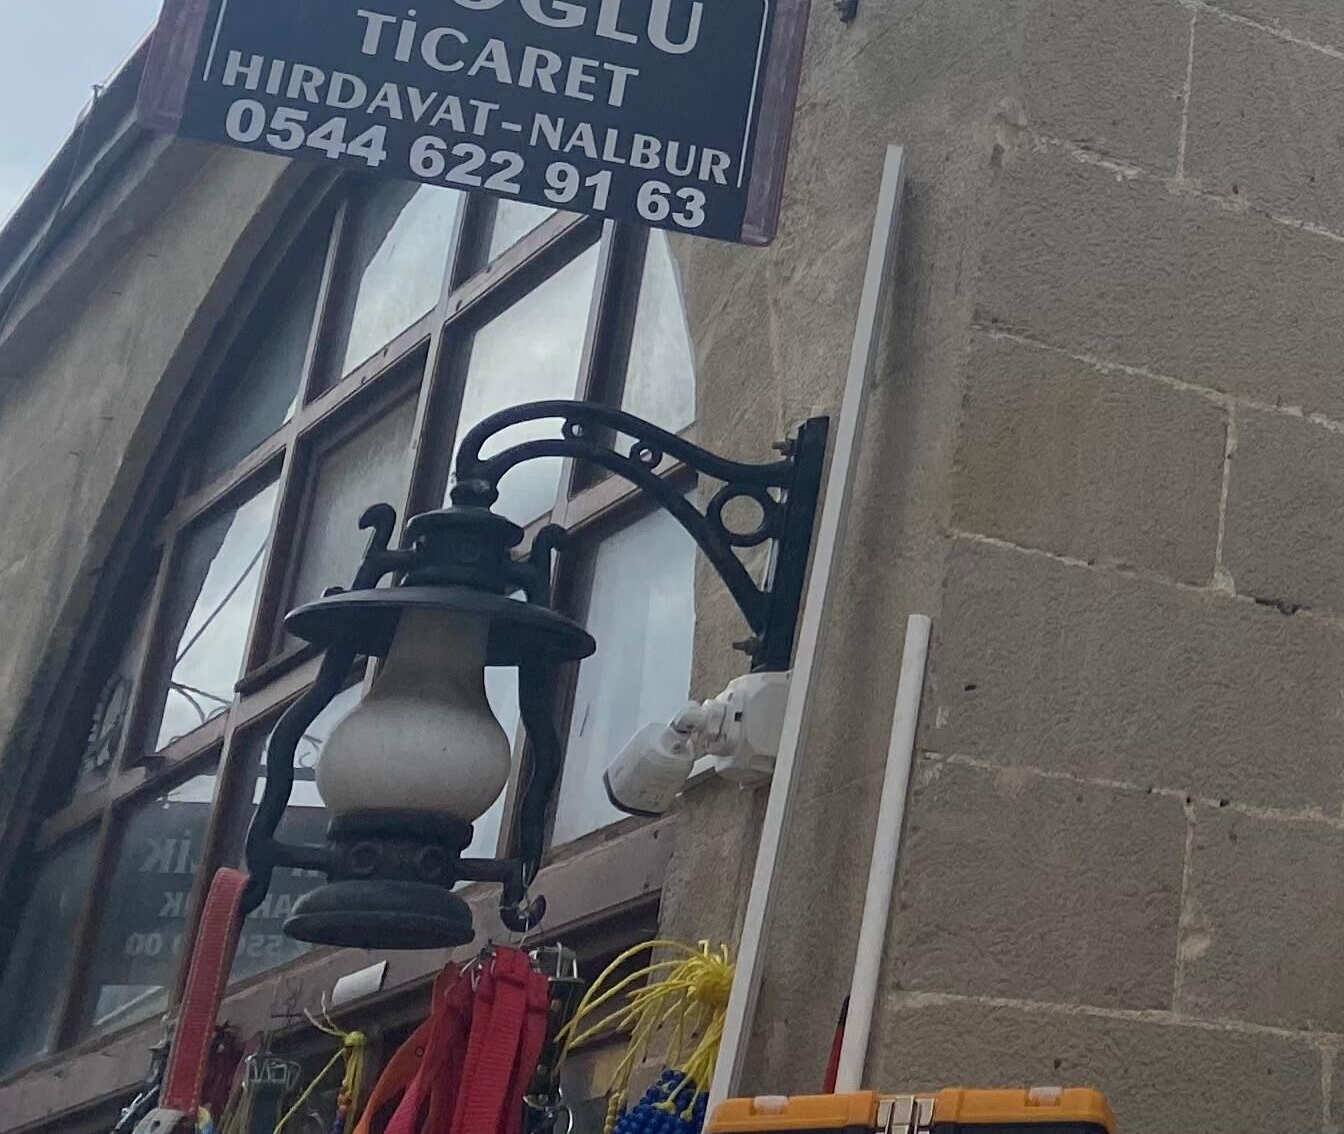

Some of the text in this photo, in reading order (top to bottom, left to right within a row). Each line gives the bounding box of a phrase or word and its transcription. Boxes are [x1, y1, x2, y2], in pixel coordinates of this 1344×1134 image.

[357, 9, 639, 108] TİCARET
[225, 98, 707, 229] 0544 622 91 63
